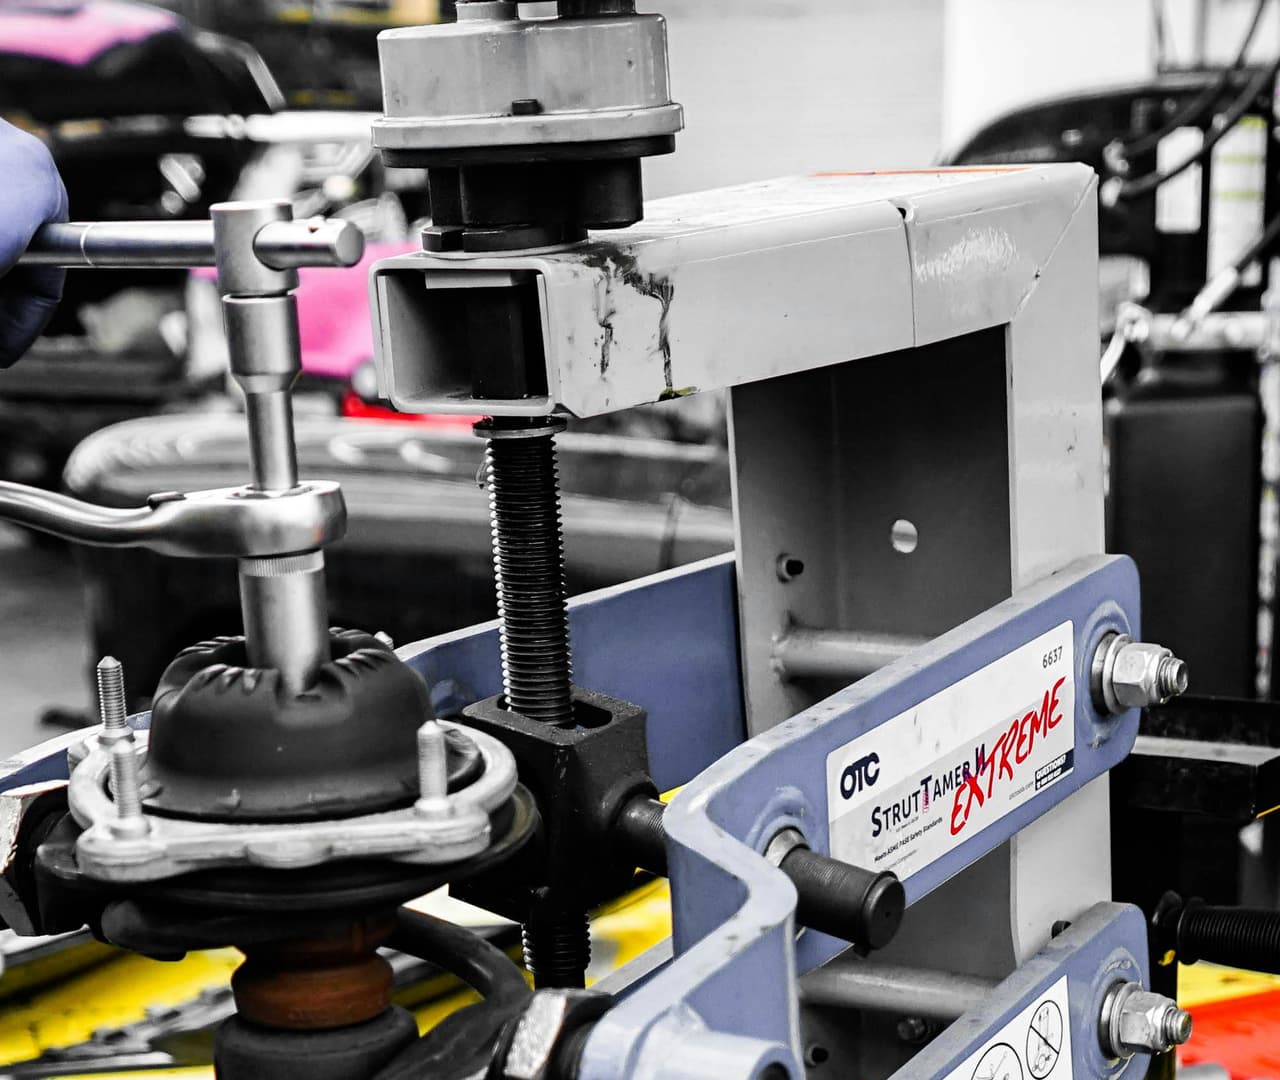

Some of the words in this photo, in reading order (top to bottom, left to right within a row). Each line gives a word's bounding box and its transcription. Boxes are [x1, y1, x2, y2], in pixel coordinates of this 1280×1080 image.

[1042, 645, 1063, 669] 6637
[840, 753, 880, 800] OTC
[950, 677, 1066, 836] EXTREME
